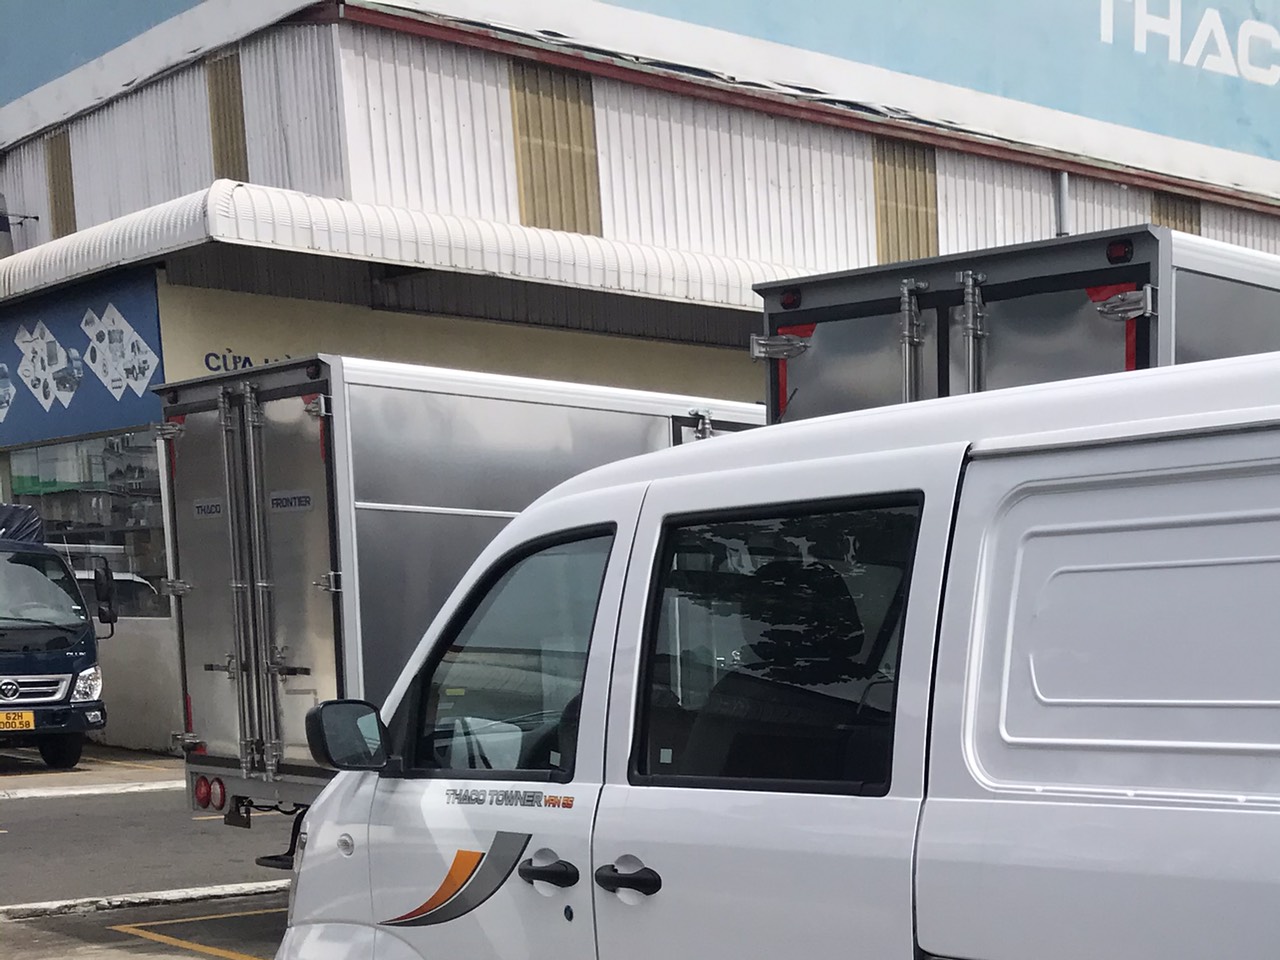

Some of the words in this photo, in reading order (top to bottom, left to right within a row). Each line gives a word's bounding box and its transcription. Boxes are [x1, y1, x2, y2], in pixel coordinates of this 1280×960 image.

[271, 495, 312, 509] FRONTIER
[195, 504, 221, 515] THACO
[5, 712, 24, 721] 62H
[445, 788, 487, 805] THACO
[487, 789, 544, 808] TOWNER
